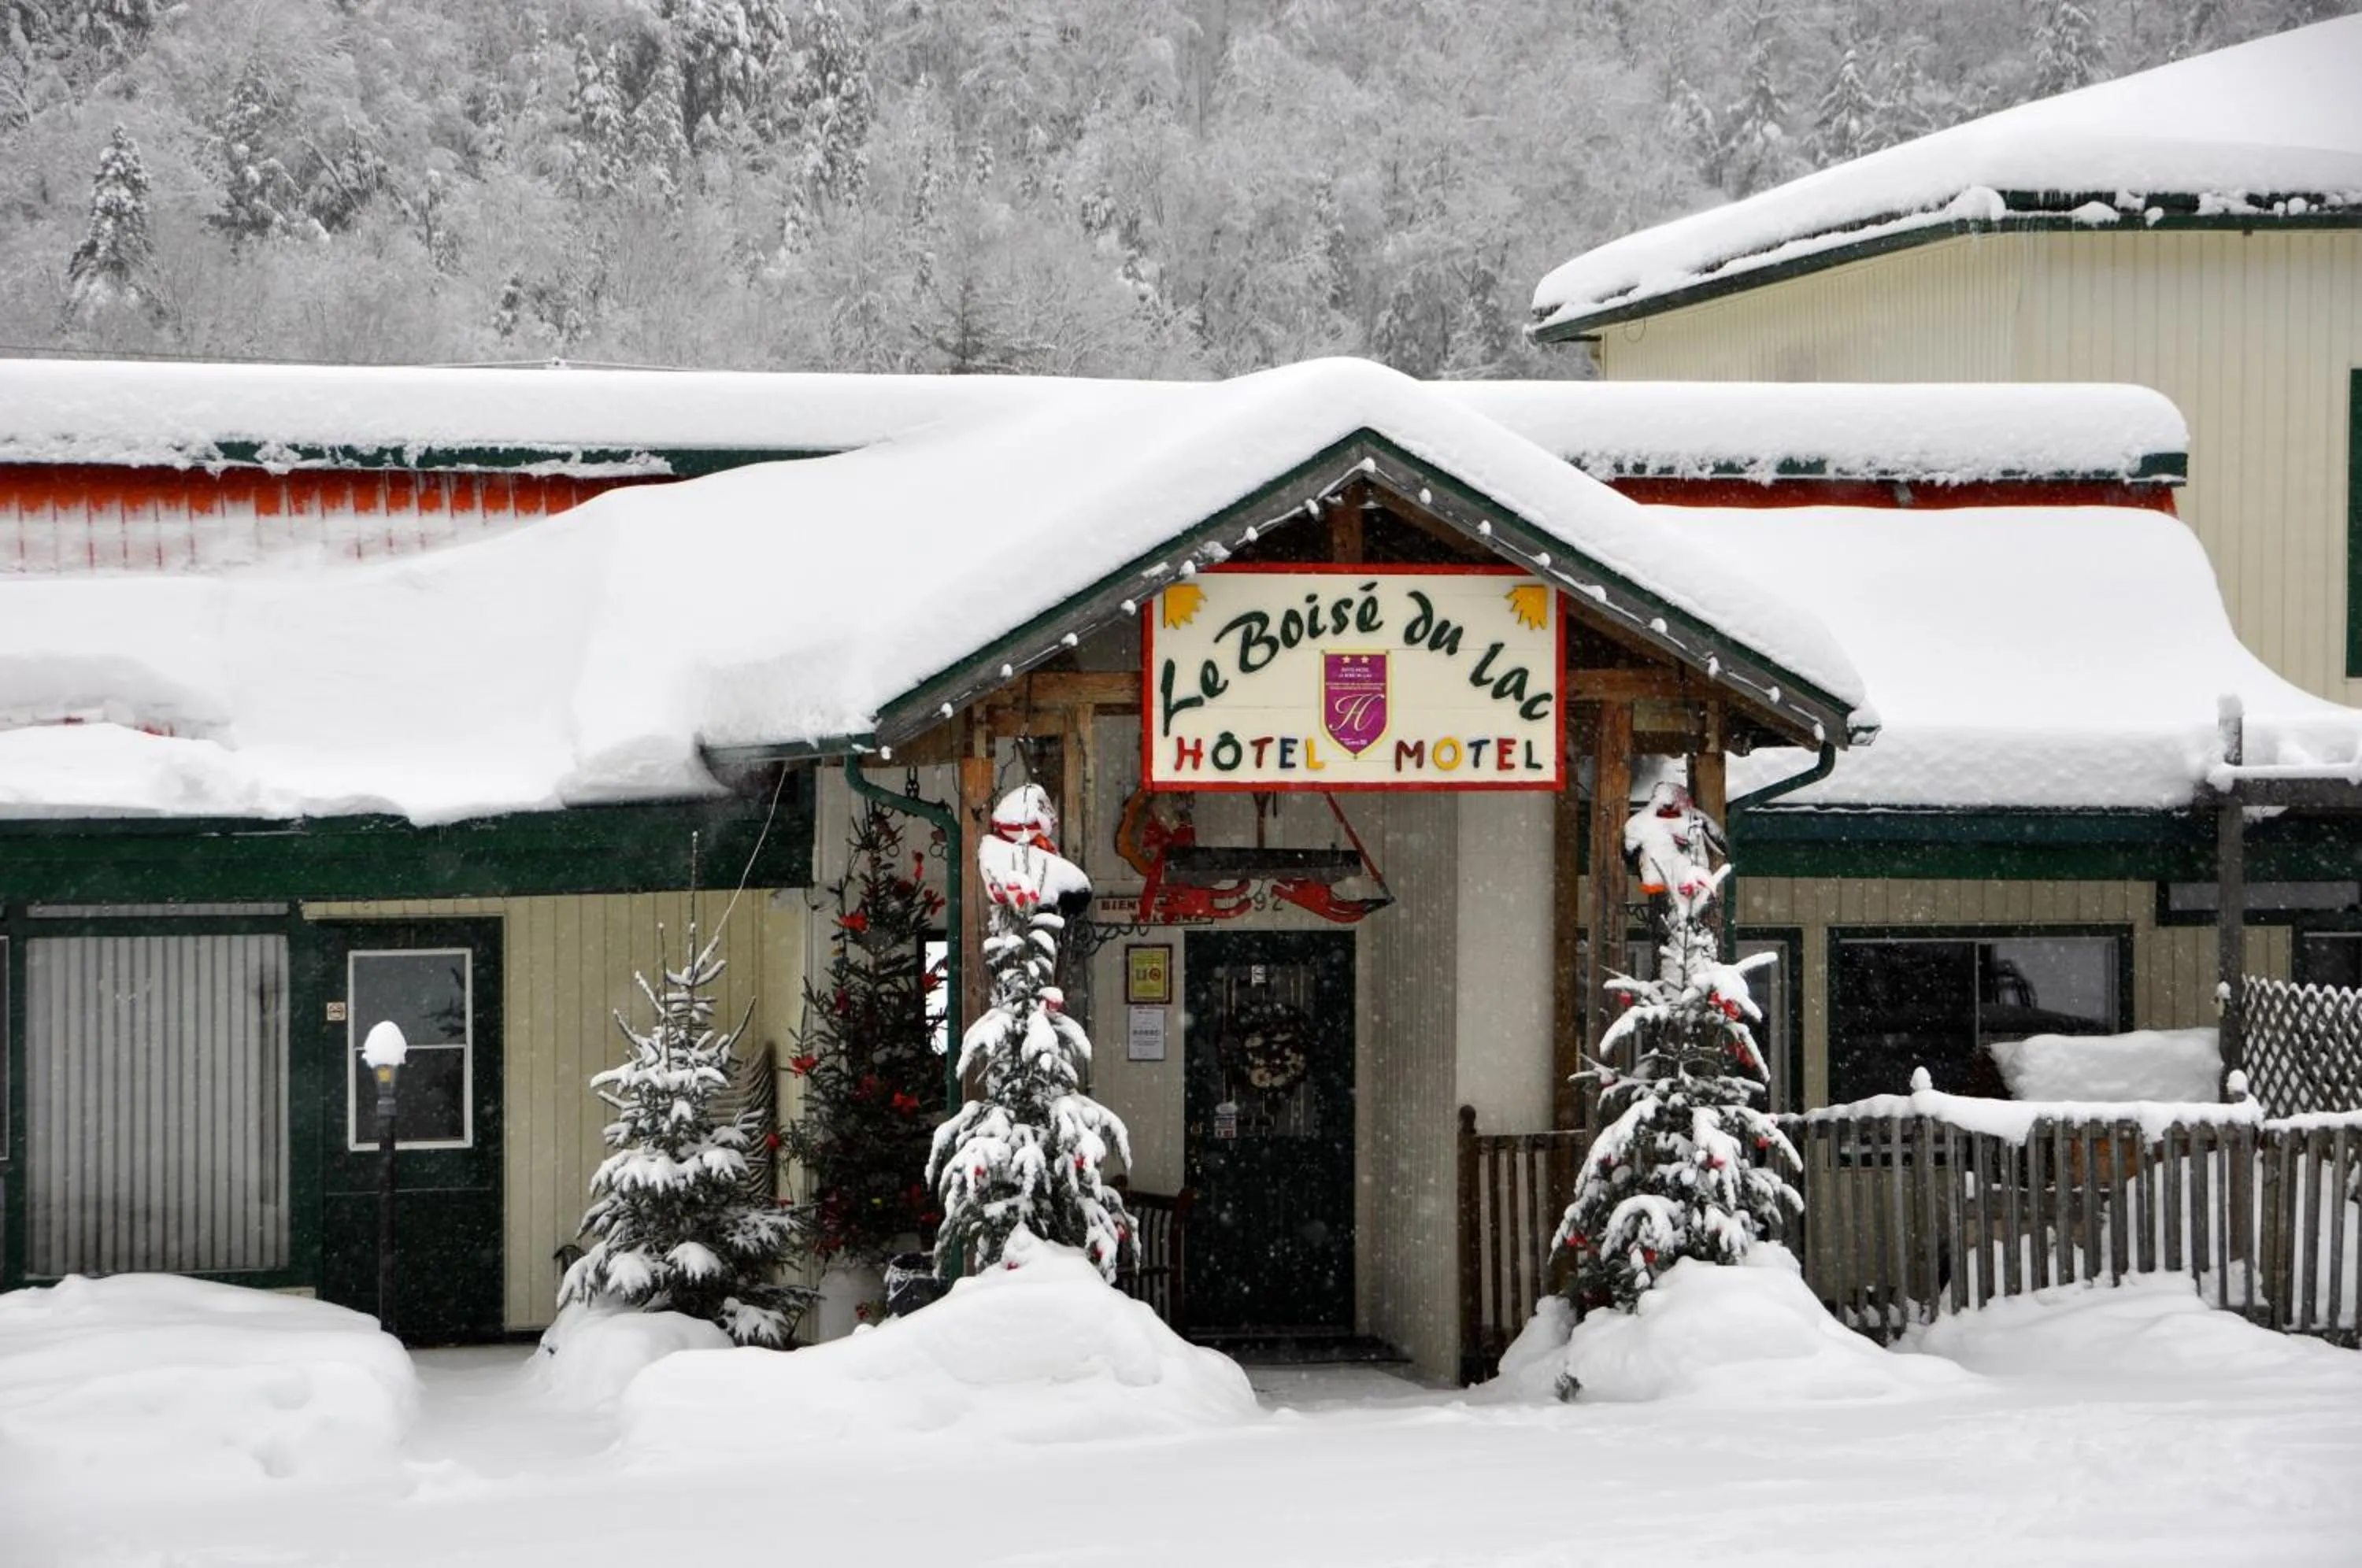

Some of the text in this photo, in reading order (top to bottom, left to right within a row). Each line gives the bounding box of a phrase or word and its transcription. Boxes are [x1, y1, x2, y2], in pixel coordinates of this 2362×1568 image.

[1161, 658, 1229, 737] Le
[1213, 582, 1384, 675] Boisé
[1404, 590, 1464, 656] du
[1174, 730, 1544, 773] HÔTEL MOTEL
